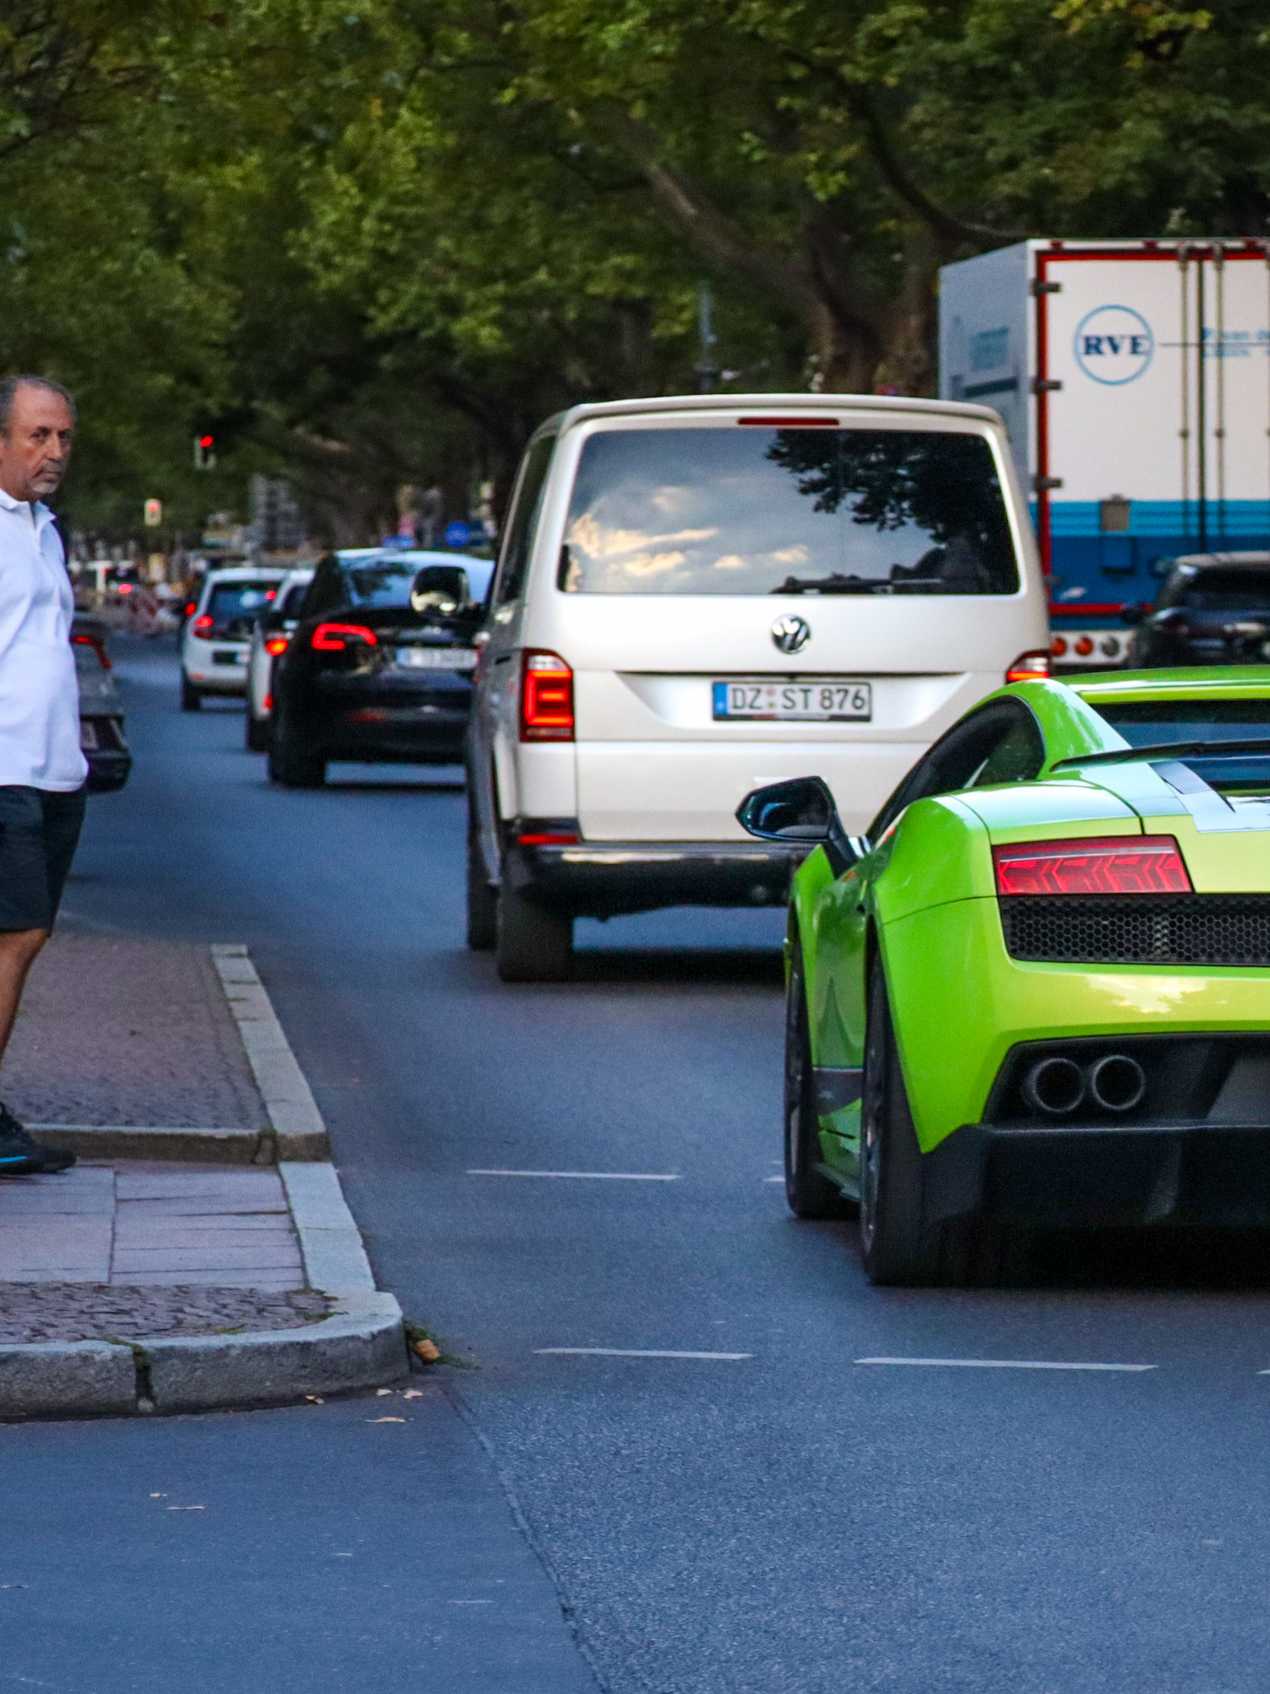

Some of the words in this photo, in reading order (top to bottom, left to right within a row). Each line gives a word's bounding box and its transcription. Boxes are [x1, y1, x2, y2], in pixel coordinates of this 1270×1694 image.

[1084, 335, 1150, 355] RVE
[732, 688, 762, 710] DZ
[781, 688, 813, 710] ST
[820, 688, 866, 710] 876
